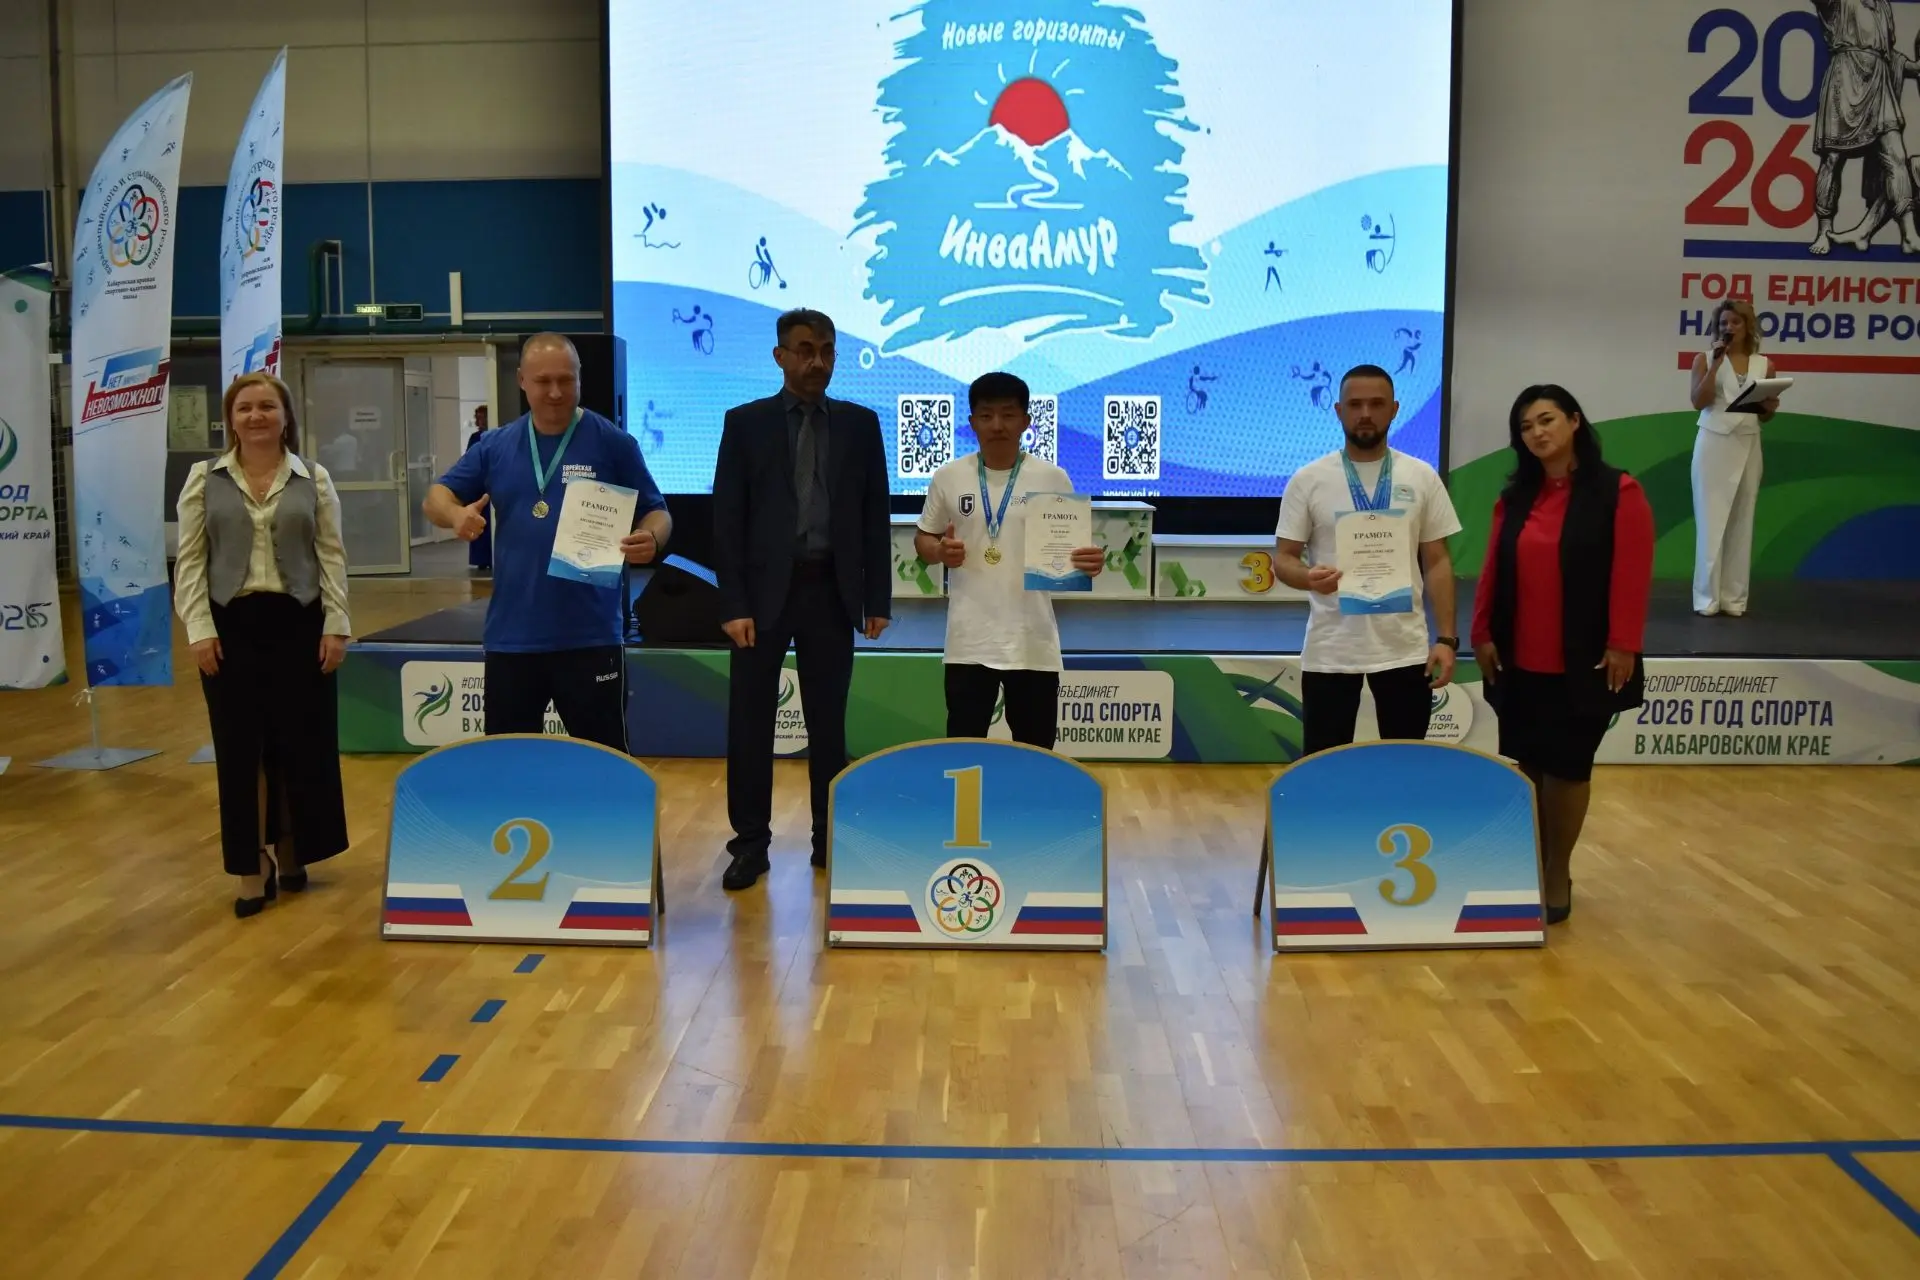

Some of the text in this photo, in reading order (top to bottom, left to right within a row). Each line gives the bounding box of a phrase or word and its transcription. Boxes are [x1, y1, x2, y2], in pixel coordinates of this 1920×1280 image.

[942, 17, 1125, 50] Новые горизонты
[1688, 8, 1830, 119] 20
[1684, 120, 1818, 229] 26
[1681, 272, 1920, 306] ГОД ЕДИНСТ
[1679, 310, 1856, 342] НОДОВ
[0, 484, 30, 502] ОД
[0, 506, 49, 521] ОРТА
[581, 500, 619, 515] ГРАМОТА
[1043, 513, 1078, 521] ГРАМОТА
[23, 530, 51, 540] КРАЙ
[1354, 531, 1393, 540] ГРАМОТА
[1240, 551, 1275, 594] 3
[1057, 685, 1120, 698] ОБЪЕДИНЯЕТ
[778, 710, 800, 719] ГОД
[1062, 702, 1162, 723] ГОД СПОРТА
[1637, 699, 1833, 728] 2026 ГОД СПОРТА
[462, 718, 470, 732] В
[775, 721, 806, 729] ПОРТ
[1055, 728, 1161, 743] АРОВСКОМ КРАЕ
[1635, 734, 1832, 756] В ХАБАРОВСКОМ КРАЕ
[943, 765, 991, 848] 1
[488, 817, 553, 901] 2
[1376, 822, 1437, 907] 3
